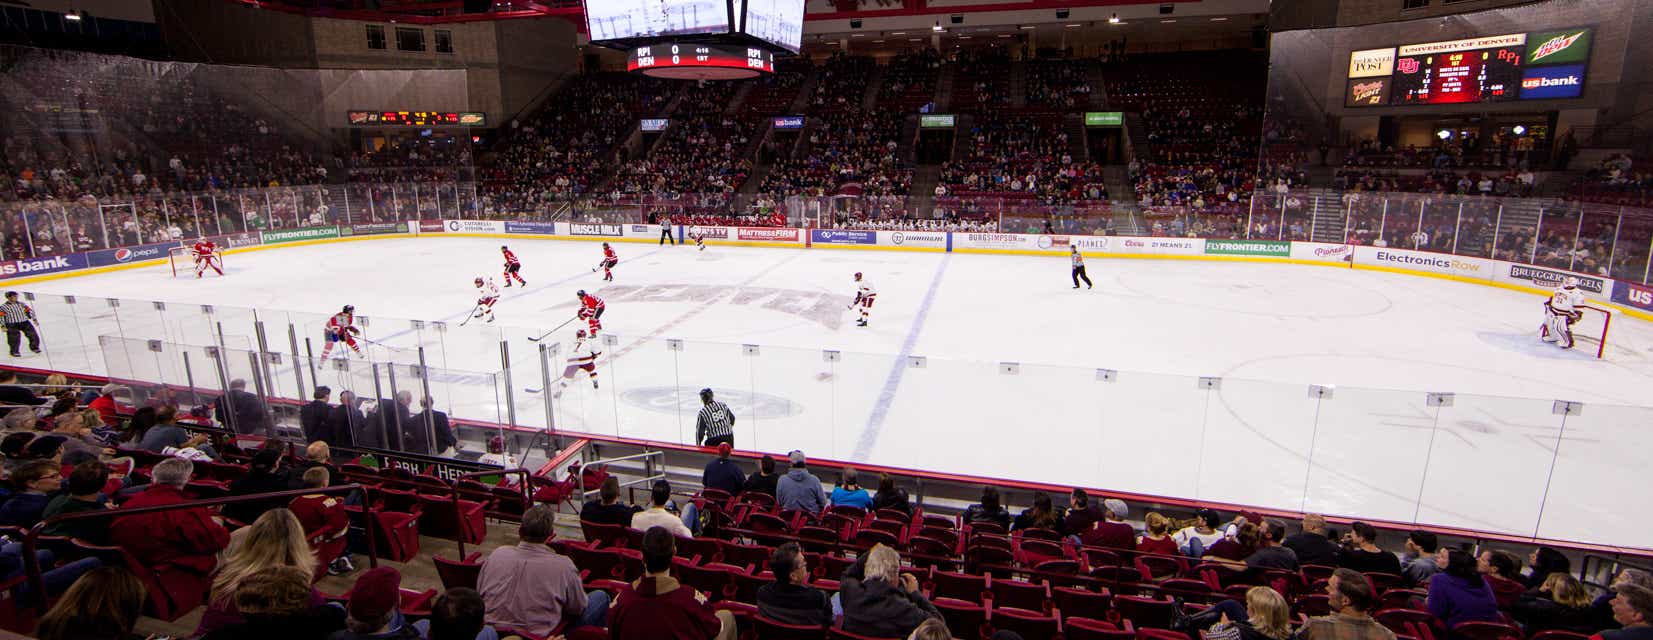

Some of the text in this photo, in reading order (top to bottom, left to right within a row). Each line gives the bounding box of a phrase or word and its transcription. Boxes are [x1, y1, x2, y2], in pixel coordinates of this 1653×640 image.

[1404, 44, 1458, 53] UNIVERSITY
[1478, 37, 1518, 46] DENVER
[637, 47, 651, 58] RPI
[671, 45, 679, 54] 0
[747, 48, 760, 58] RPI
[1497, 49, 1521, 66] RPI
[637, 56, 655, 66] DEN
[672, 55, 680, 64] 0
[747, 57, 764, 68] DEN
[1354, 62, 1382, 73] POST
[263, 227, 338, 242] FLYFRONTIER.COM
[571, 223, 600, 234] MUSCLE
[601, 224, 620, 235] MILK
[133, 247, 160, 260] pepsi
[1206, 242, 1290, 254] FLYFRONTIER.COM
[712, 410, 725, 422] 88
